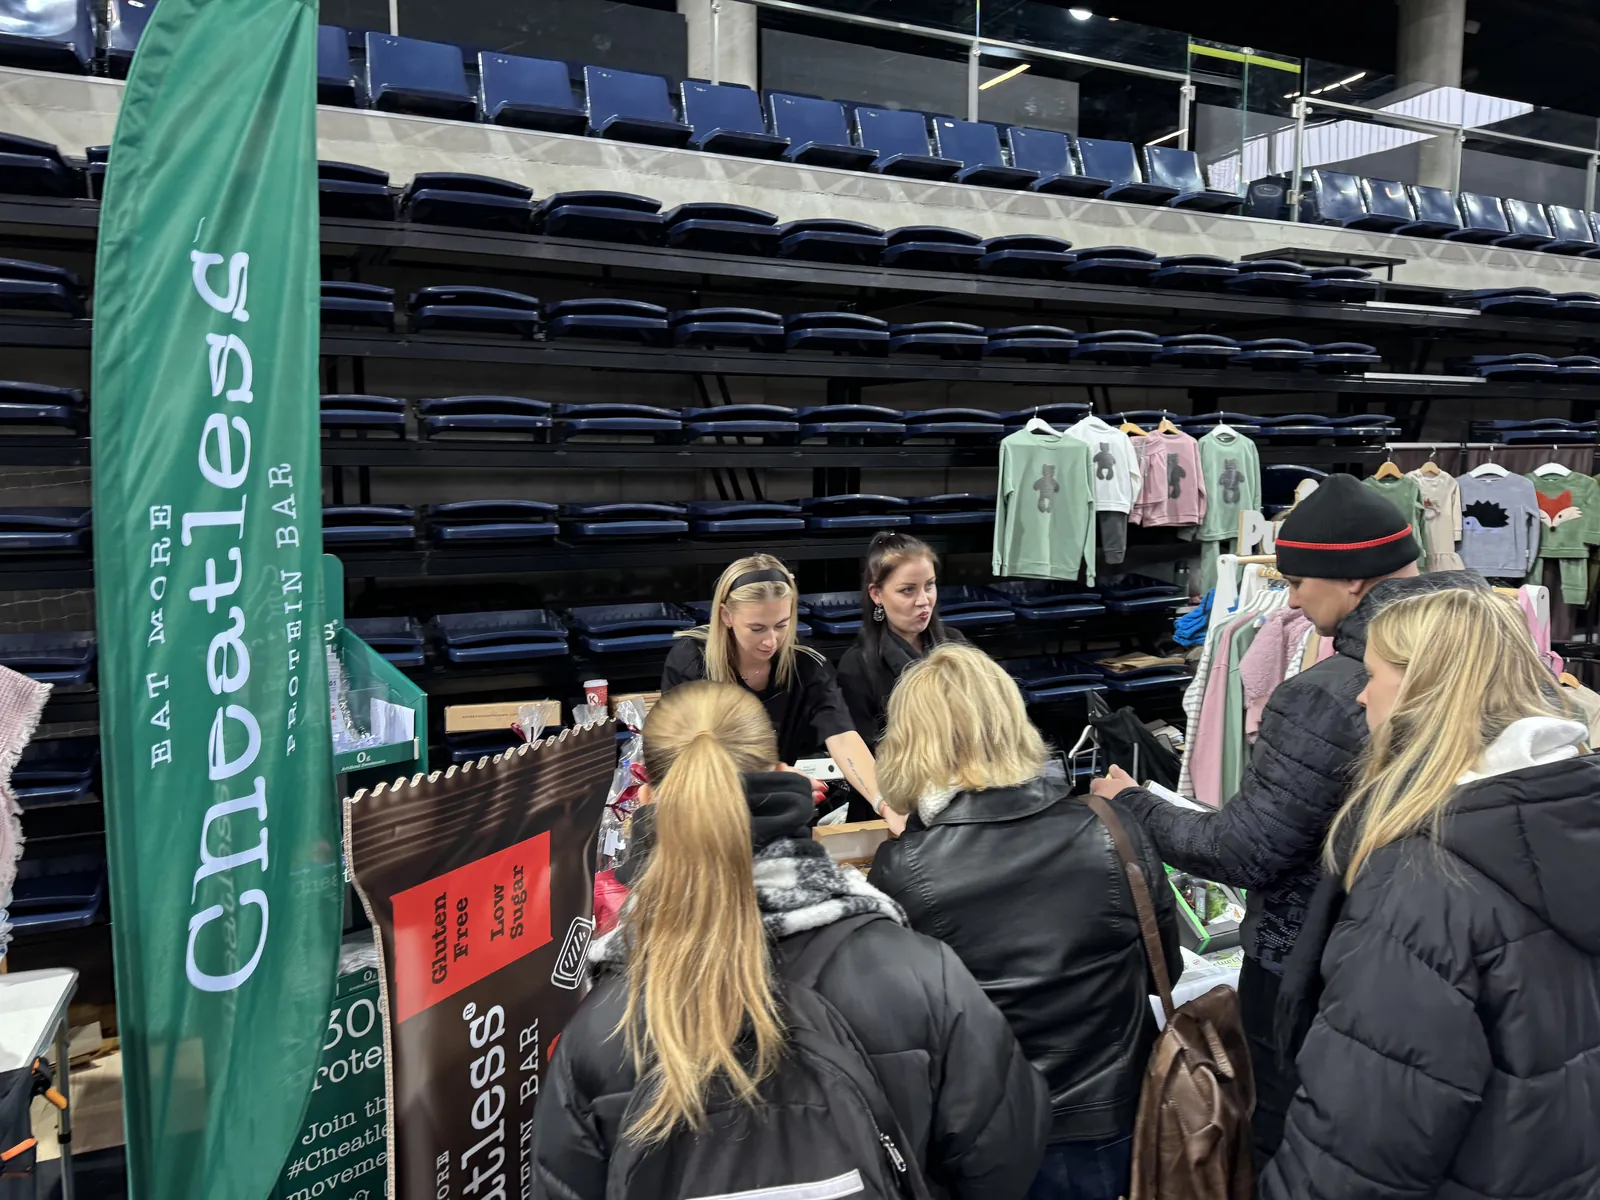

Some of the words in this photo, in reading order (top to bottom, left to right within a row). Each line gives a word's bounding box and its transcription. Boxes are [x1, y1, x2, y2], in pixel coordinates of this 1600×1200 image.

[268, 463, 300, 549] BAR
[148, 505, 171, 647] MORE
[280, 569, 302, 756] PROTEIN
[147, 672, 172, 769] EAT
[432, 892, 448, 985] Gluten
[454, 897, 469, 962] Free
[491, 884, 505, 942] Low
[510, 865, 528, 940] Sugar
[519, 1018, 539, 1105] BAR
[302, 1112, 358, 1146] Join
